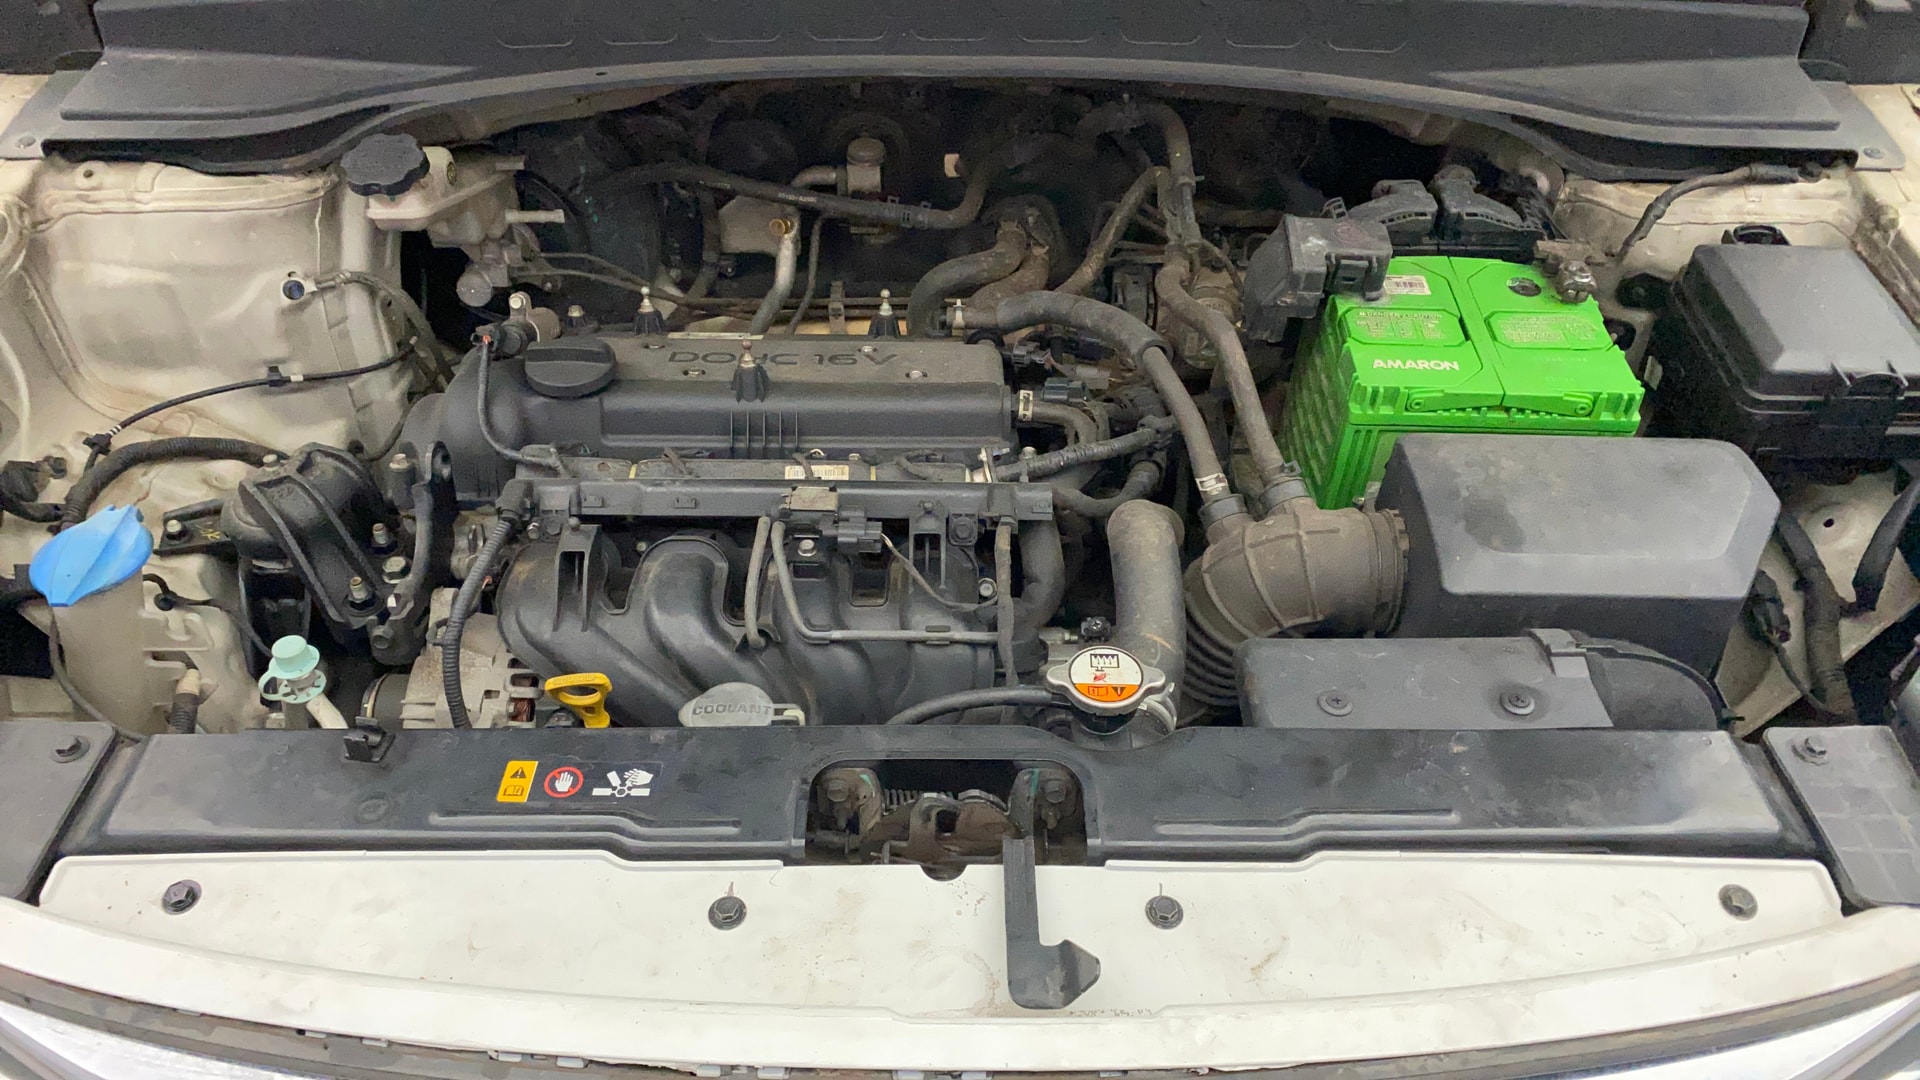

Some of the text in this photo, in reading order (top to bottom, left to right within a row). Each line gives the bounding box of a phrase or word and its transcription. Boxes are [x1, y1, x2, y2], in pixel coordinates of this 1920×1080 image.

[814, 353, 898, 366] 16V
[1373, 359, 1460, 371] AMARON
[692, 703, 772, 716] COOLANT
